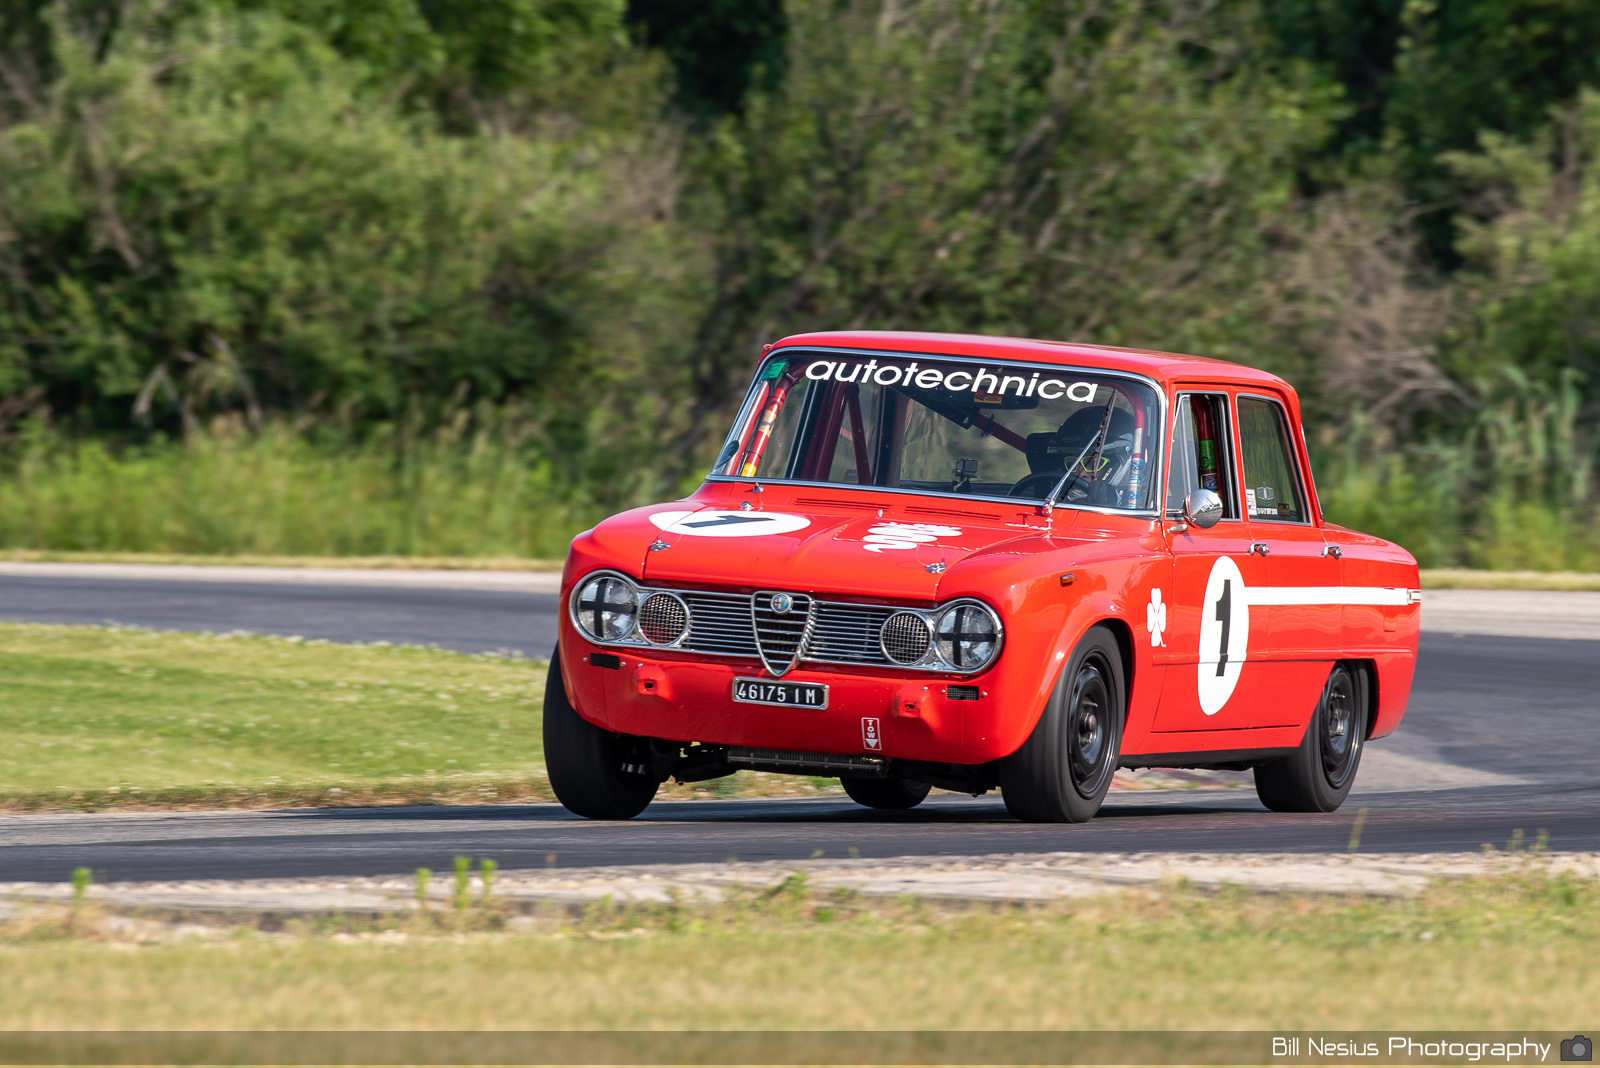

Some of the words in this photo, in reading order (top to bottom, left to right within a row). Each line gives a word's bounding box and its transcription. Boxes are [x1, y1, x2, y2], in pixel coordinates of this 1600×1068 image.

[805, 359, 1099, 403] autotechnica
[681, 515, 777, 528] 1
[1215, 579, 1231, 677] 1
[738, 683, 786, 702] 46175
[805, 689, 816, 704] M
[866, 719, 876, 738] TOW
